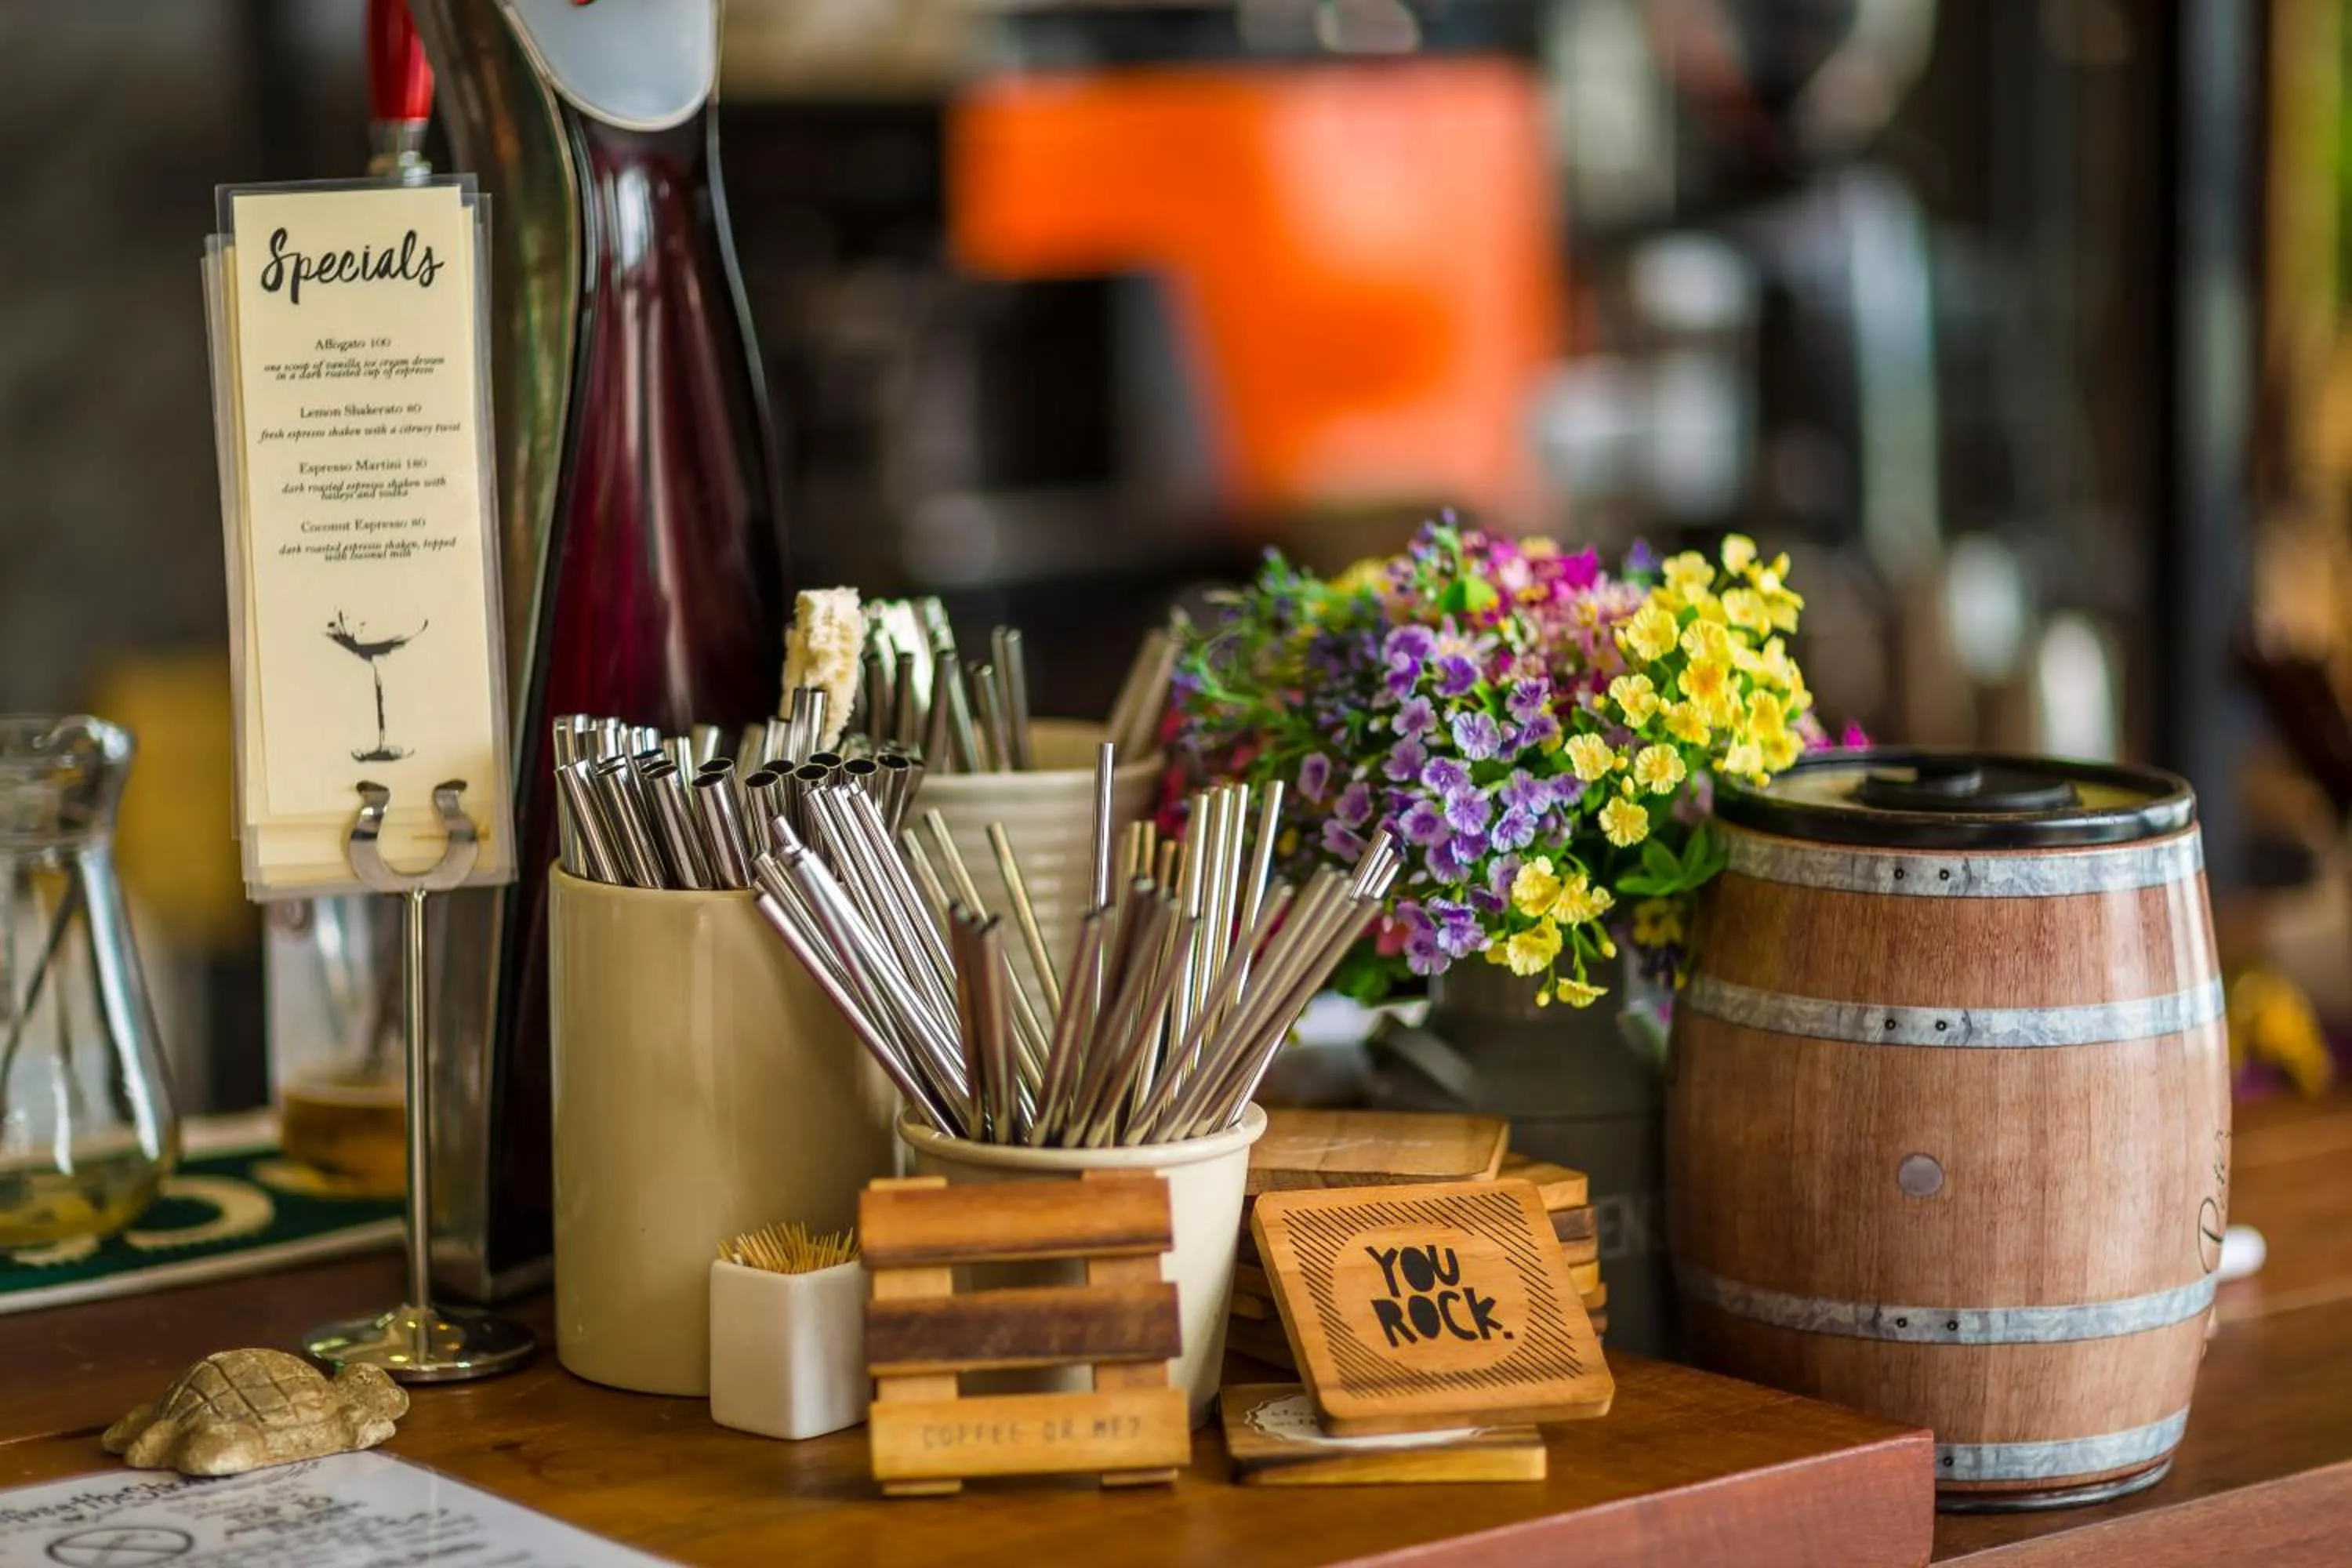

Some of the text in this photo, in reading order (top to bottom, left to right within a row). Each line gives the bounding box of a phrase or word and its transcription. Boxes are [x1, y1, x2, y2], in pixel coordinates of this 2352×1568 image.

[261, 227, 445, 305] Specials
[314, 338, 391, 352] Affogato 100
[285, 362, 308, 372] scoop
[326, 358, 361, 369] vanilla
[299, 370, 321, 379] dark
[326, 368, 361, 377] roasted
[363, 368, 379, 379] cup
[395, 366, 435, 378] espresso
[299, 407, 341, 418] Lemon
[344, 405, 403, 416] Shakerato
[257, 430, 284, 443] fresh
[287, 428, 325, 442] espresso
[328, 426, 361, 436] shaken
[365, 425, 387, 435] with
[436, 423, 460, 431] twist
[299, 462, 352, 477] Espresso
[355, 459, 401, 471] Martini
[281, 484, 304, 494] dark
[308, 481, 344, 492] roasted
[424, 477, 446, 487] with
[301, 521, 350, 533] Coconut
[355, 519, 407, 533] Espresso
[279, 545, 302, 555] dark
[1364, 1244, 1461, 1298] YOU
[1370, 1287, 1515, 1348] ROCK.
[922, 1414, 1142, 1450] COFFEE OR ME?
